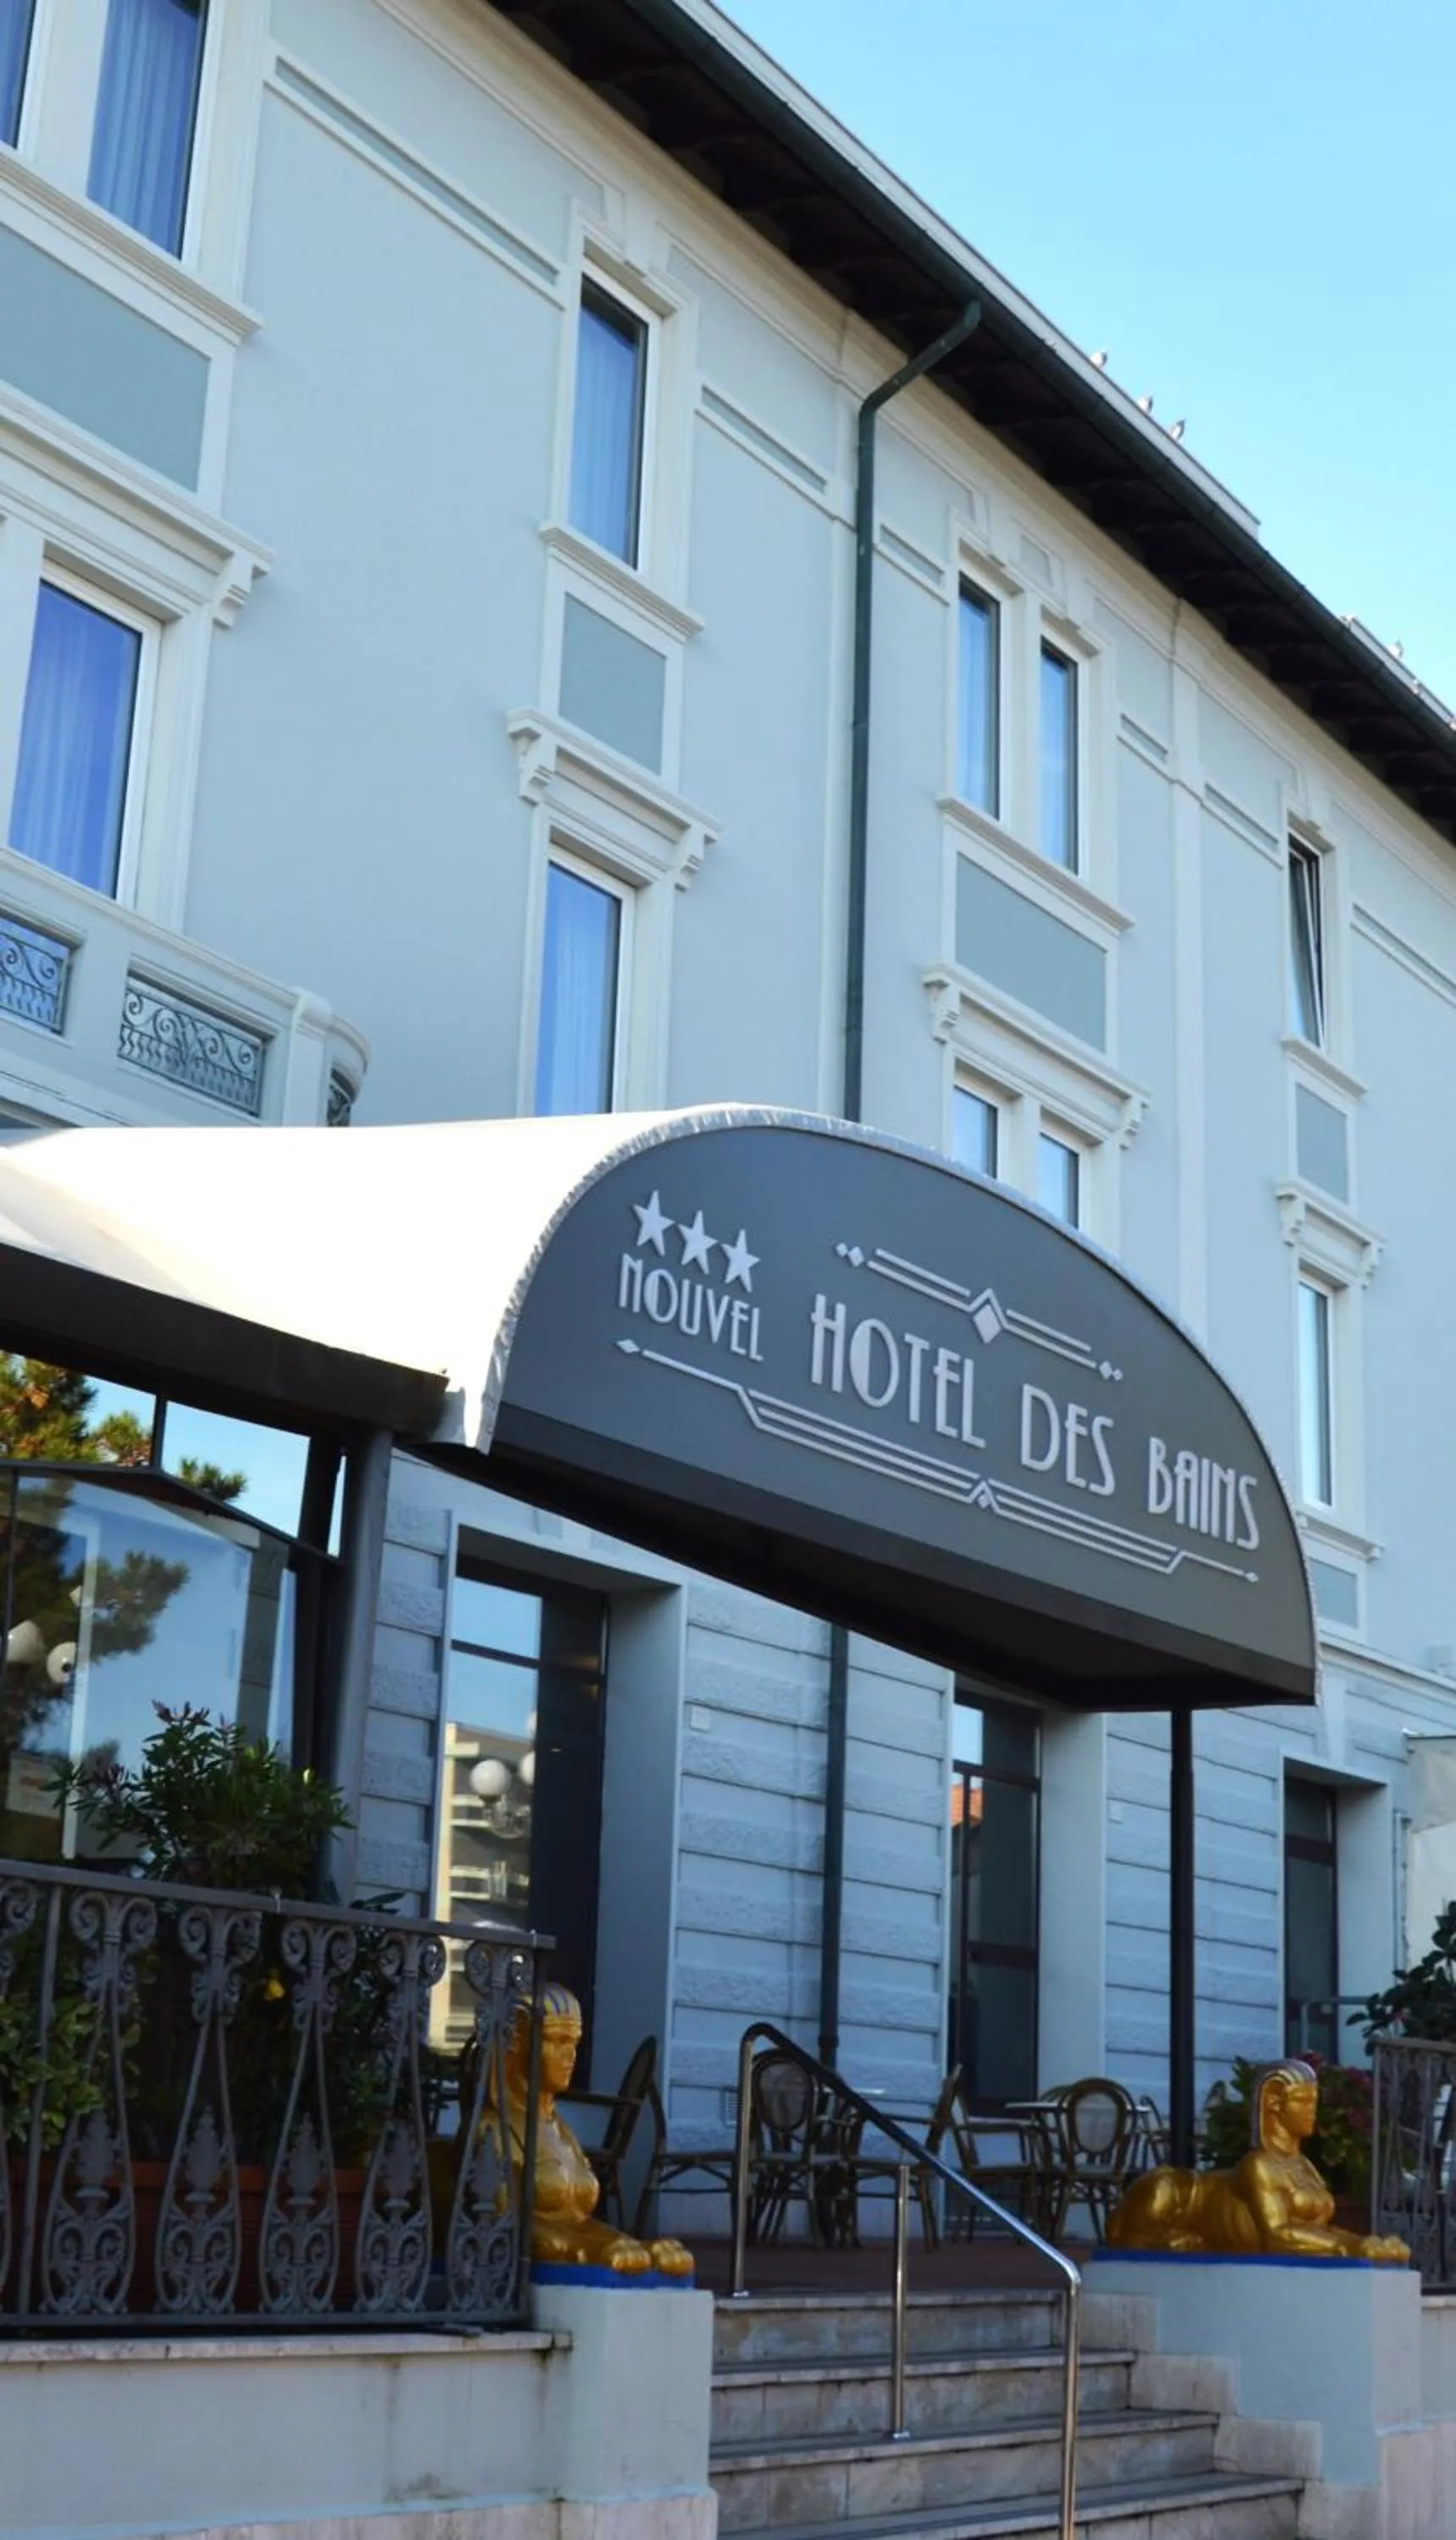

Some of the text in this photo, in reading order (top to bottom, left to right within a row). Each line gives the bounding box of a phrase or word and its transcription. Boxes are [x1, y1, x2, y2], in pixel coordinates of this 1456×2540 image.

[619, 1253, 1259, 1551] NOUVEL HOTEL DES BAINS
